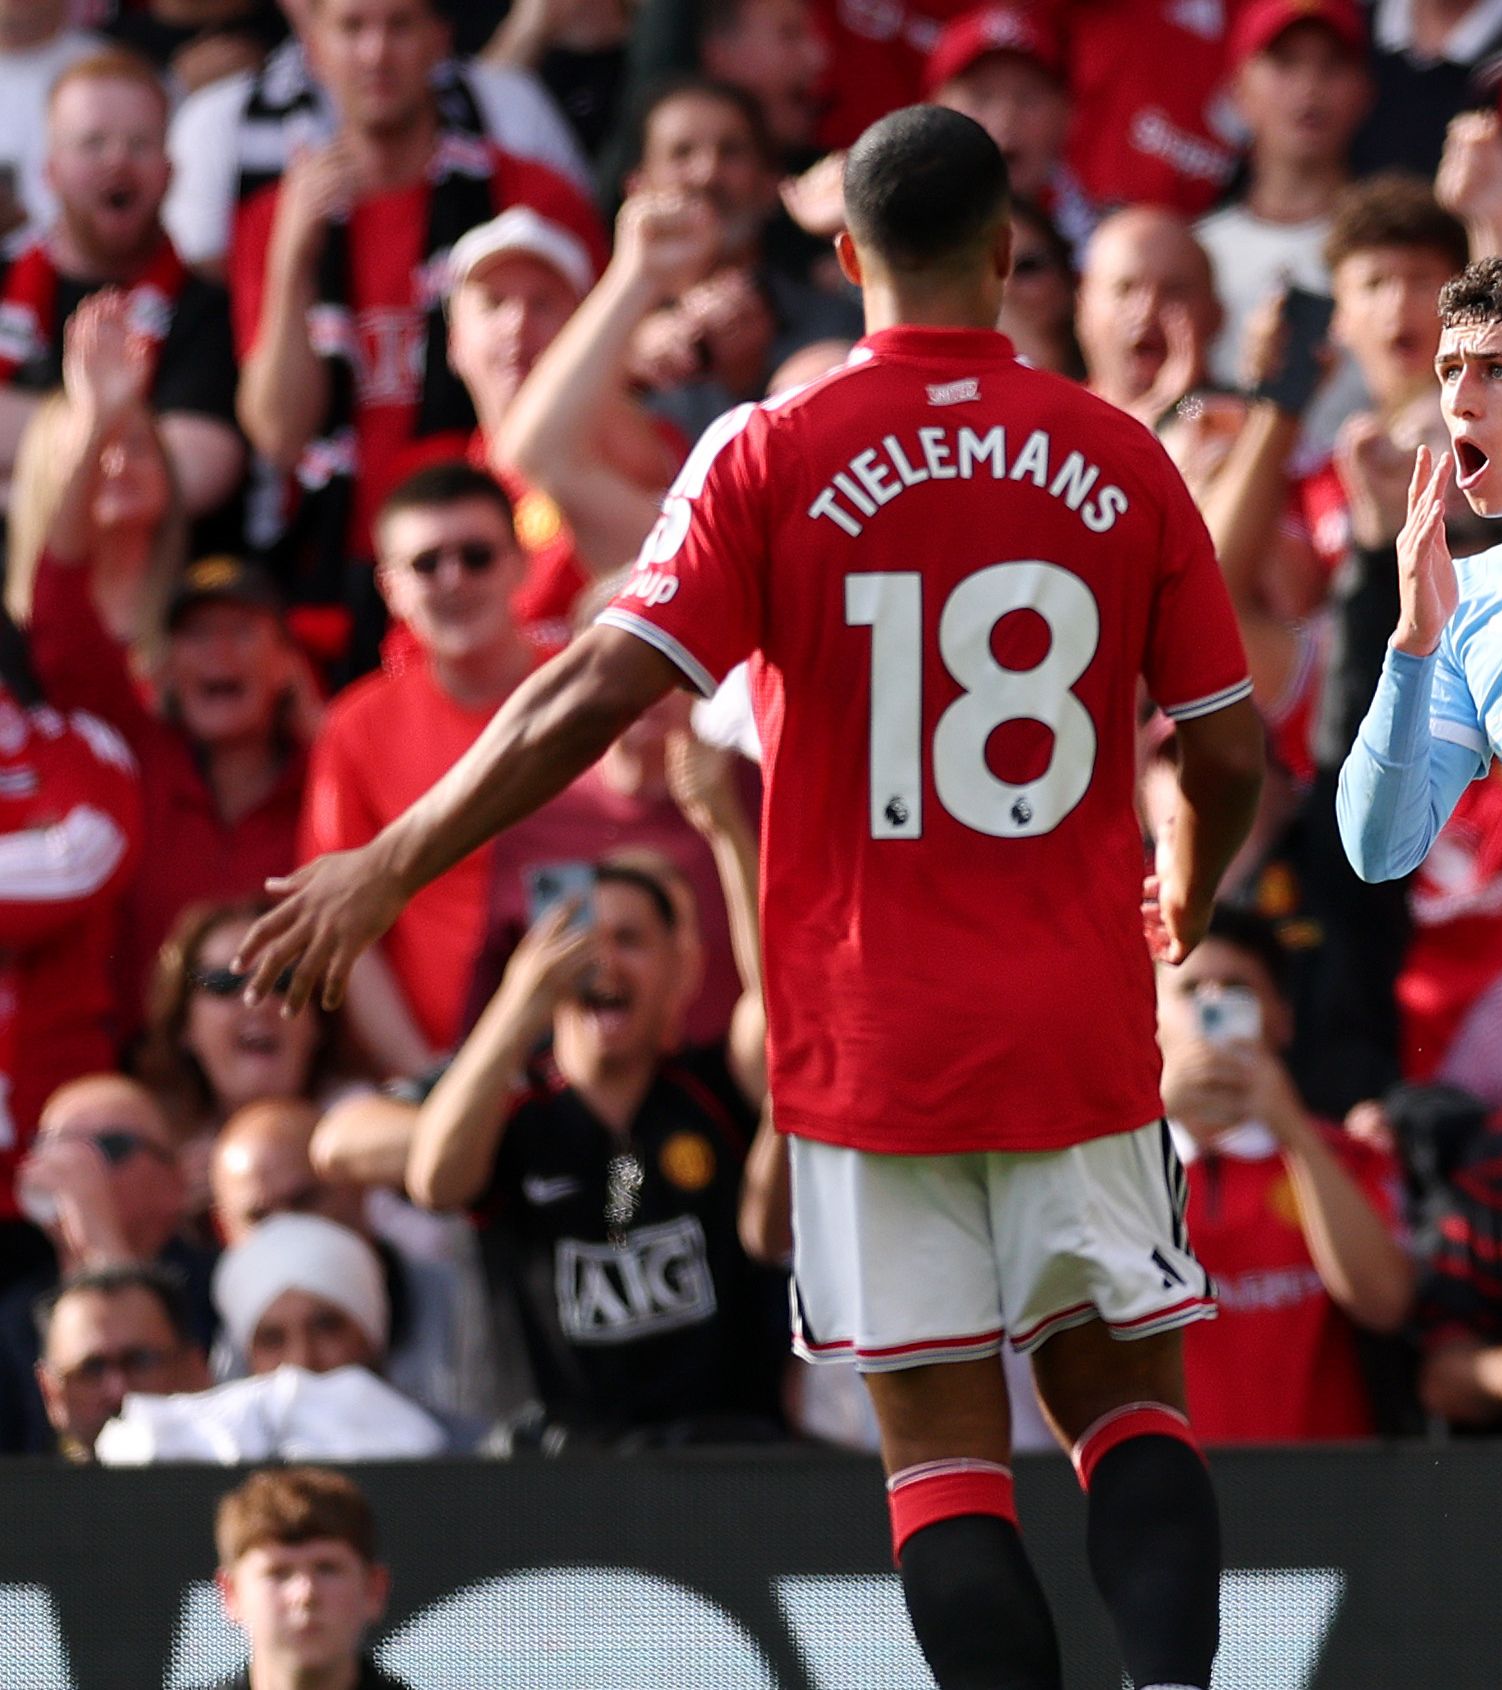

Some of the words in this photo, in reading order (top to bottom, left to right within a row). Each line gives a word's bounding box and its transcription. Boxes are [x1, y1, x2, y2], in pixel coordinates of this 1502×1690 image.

[807, 425, 1129, 539] TIELEMANS
[844, 559, 1100, 840] 18
[570, 1230, 706, 1331] AIG
